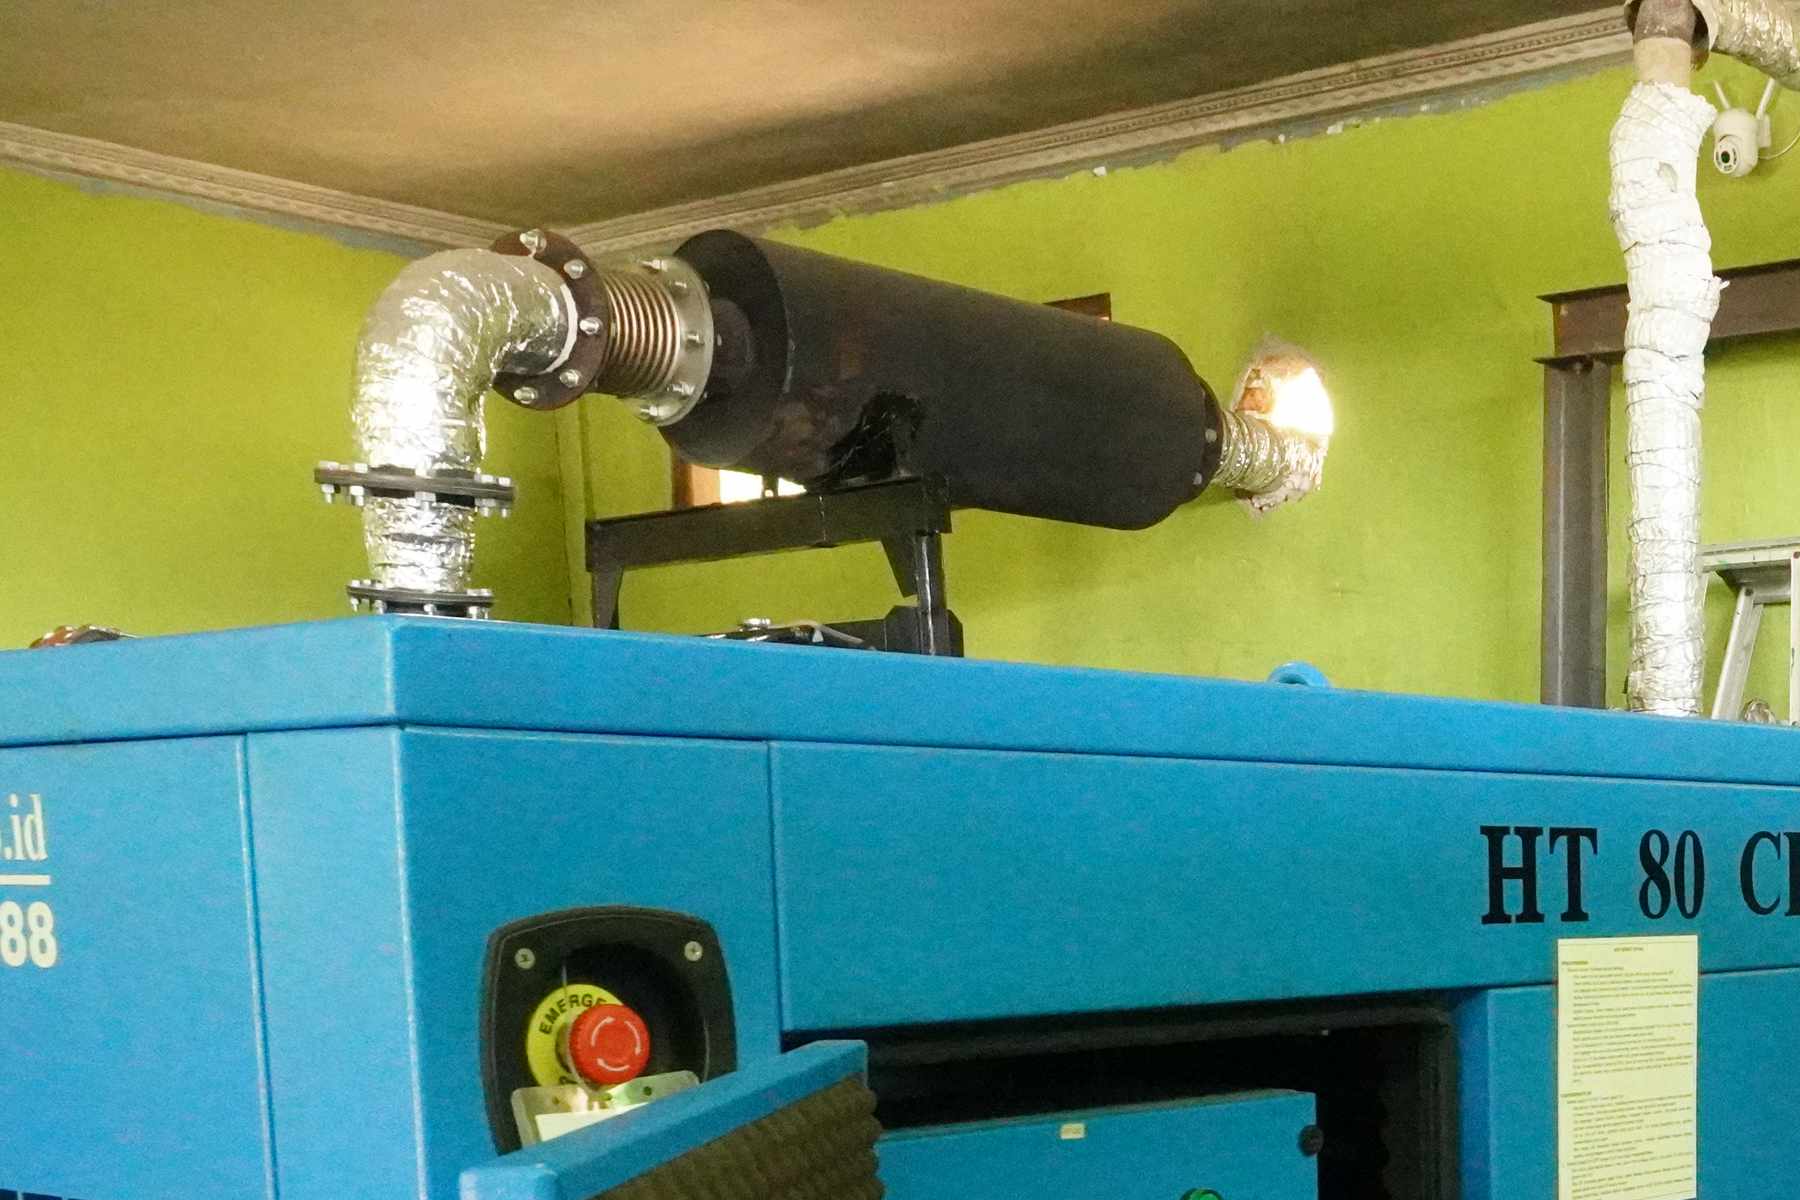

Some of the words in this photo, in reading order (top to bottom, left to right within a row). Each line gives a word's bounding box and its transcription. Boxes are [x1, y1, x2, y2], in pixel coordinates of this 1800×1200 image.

[0, 793, 49, 861] .id
[1480, 825, 1597, 925] HT
[1638, 829, 1705, 920] 80
